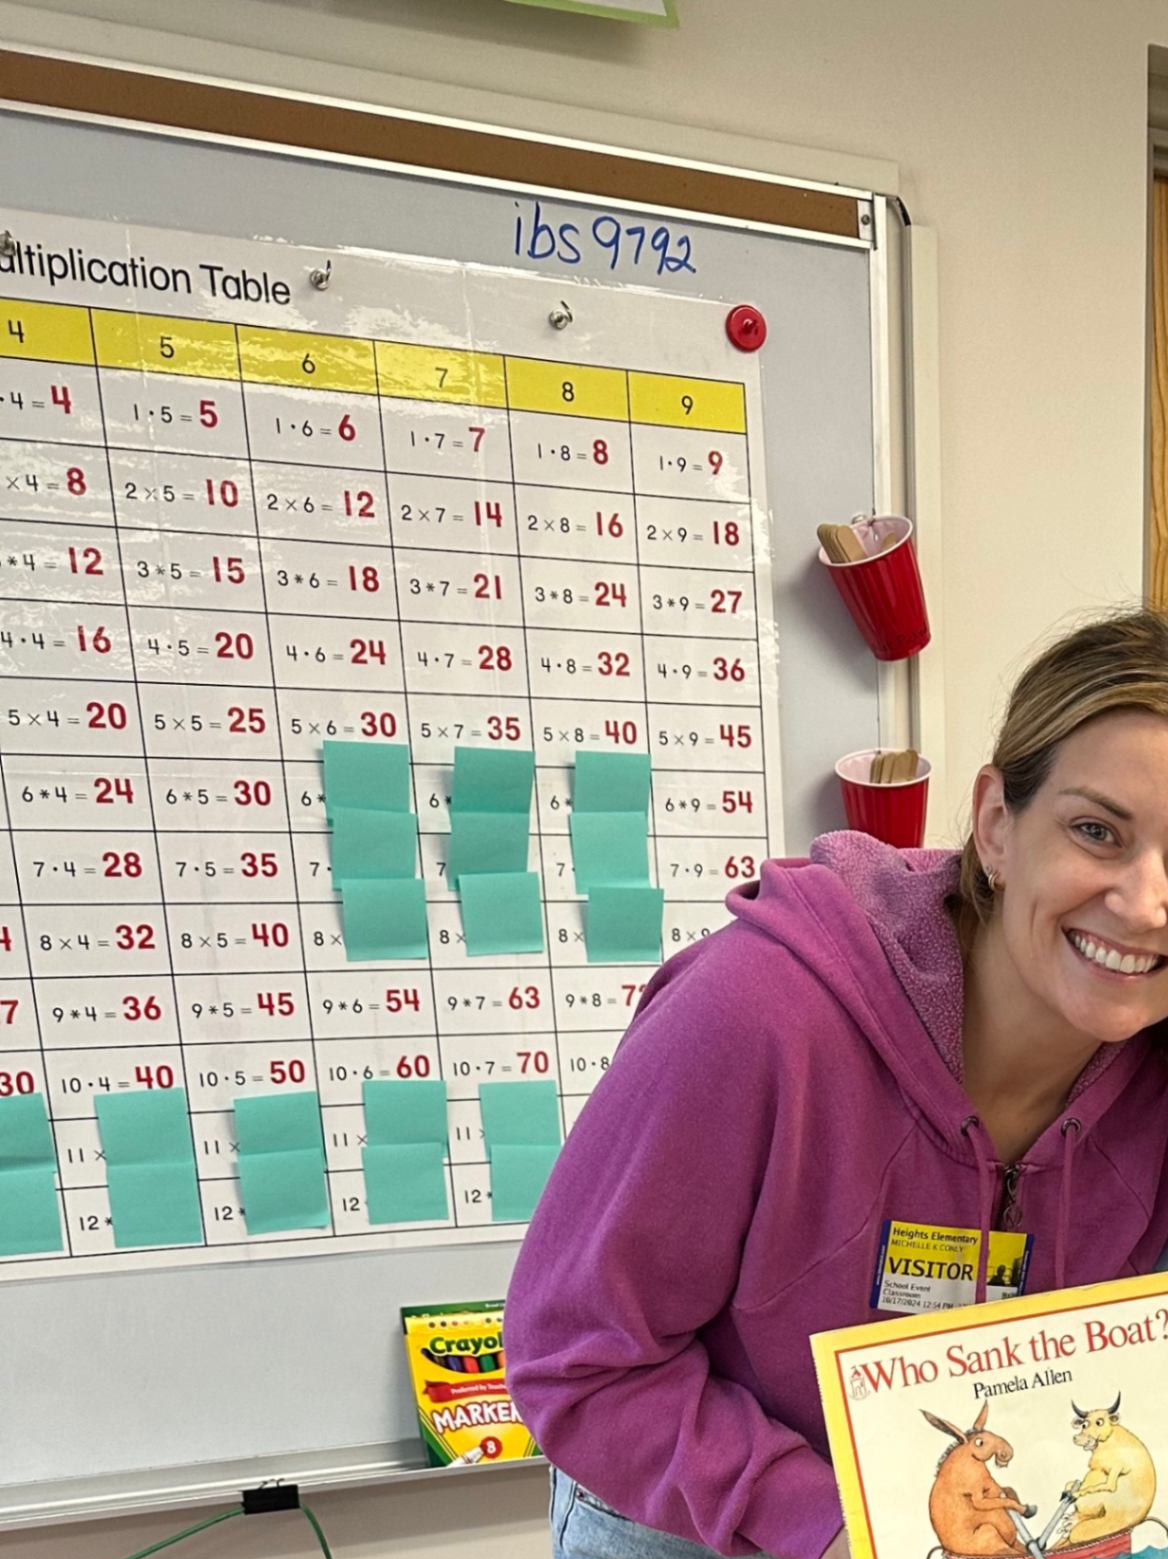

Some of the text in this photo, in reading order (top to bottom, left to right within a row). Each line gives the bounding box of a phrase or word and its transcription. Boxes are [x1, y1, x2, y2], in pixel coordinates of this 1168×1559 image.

[512, 201, 698, 276] ibs 9792
[200, 264, 292, 306] Table
[8, 320, 694, 417] 4 5 6 7 8 9
[206, 479, 239, 507] 10
[344, 490, 375, 518] 12
[474, 502, 503, 527] 14
[596, 512, 624, 538] 16
[712, 522, 740, 546] 18
[69, 547, 104, 576] 12
[213, 557, 245, 584] 15
[474, 575, 502, 600] 21
[595, 583, 627, 607] 24
[711, 590, 743, 613] 27
[78, 626, 112, 653] 16
[215, 632, 254, 660] 20
[351, 639, 386, 664] 24
[360, 712, 397, 737] 30
[720, 724, 752, 748] 45
[94, 777, 134, 804] 24
[722, 791, 753, 813] 54
[724, 856, 756, 878] 63
[116, 924, 155, 949] 32
[386, 989, 421, 1013] 54
[893, 1227, 978, 1246] Heights Elementary
[888, 1256, 974, 1282] VISITOR
[884, 1279, 909, 1289] School
[429, 1331, 503, 1355] Crayol
[858, 1354, 939, 1394] Who
[946, 1337, 1024, 1379] Sank
[1029, 1328, 1078, 1359] the
[972, 1367, 1073, 1401] Pamela Allen
[431, 1400, 524, 1435] MARKER
[485, 1440, 497, 1455] 8
